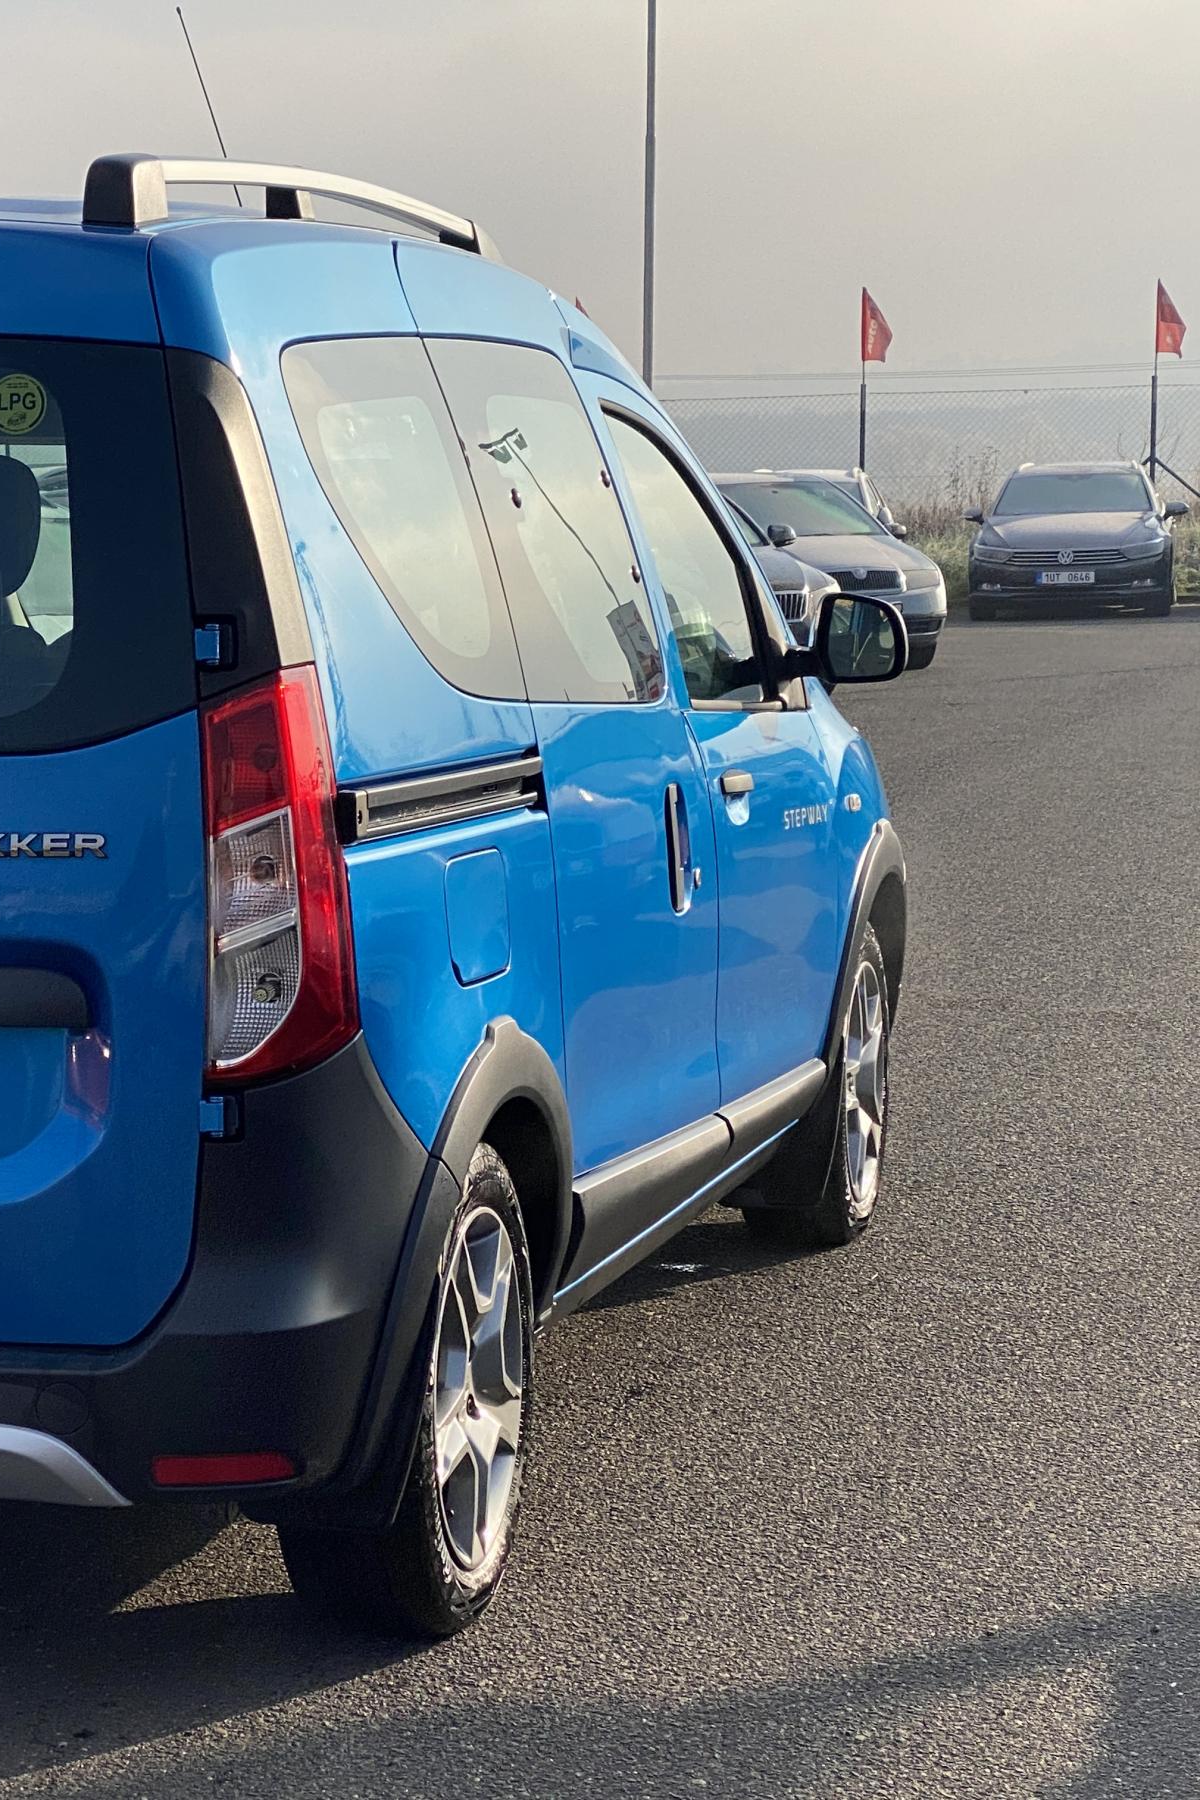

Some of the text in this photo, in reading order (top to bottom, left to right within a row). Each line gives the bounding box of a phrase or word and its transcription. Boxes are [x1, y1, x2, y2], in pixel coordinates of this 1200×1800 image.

[1044, 572, 1090, 583] 1UT 0646
[783, 803, 828, 831] STEPWAY
